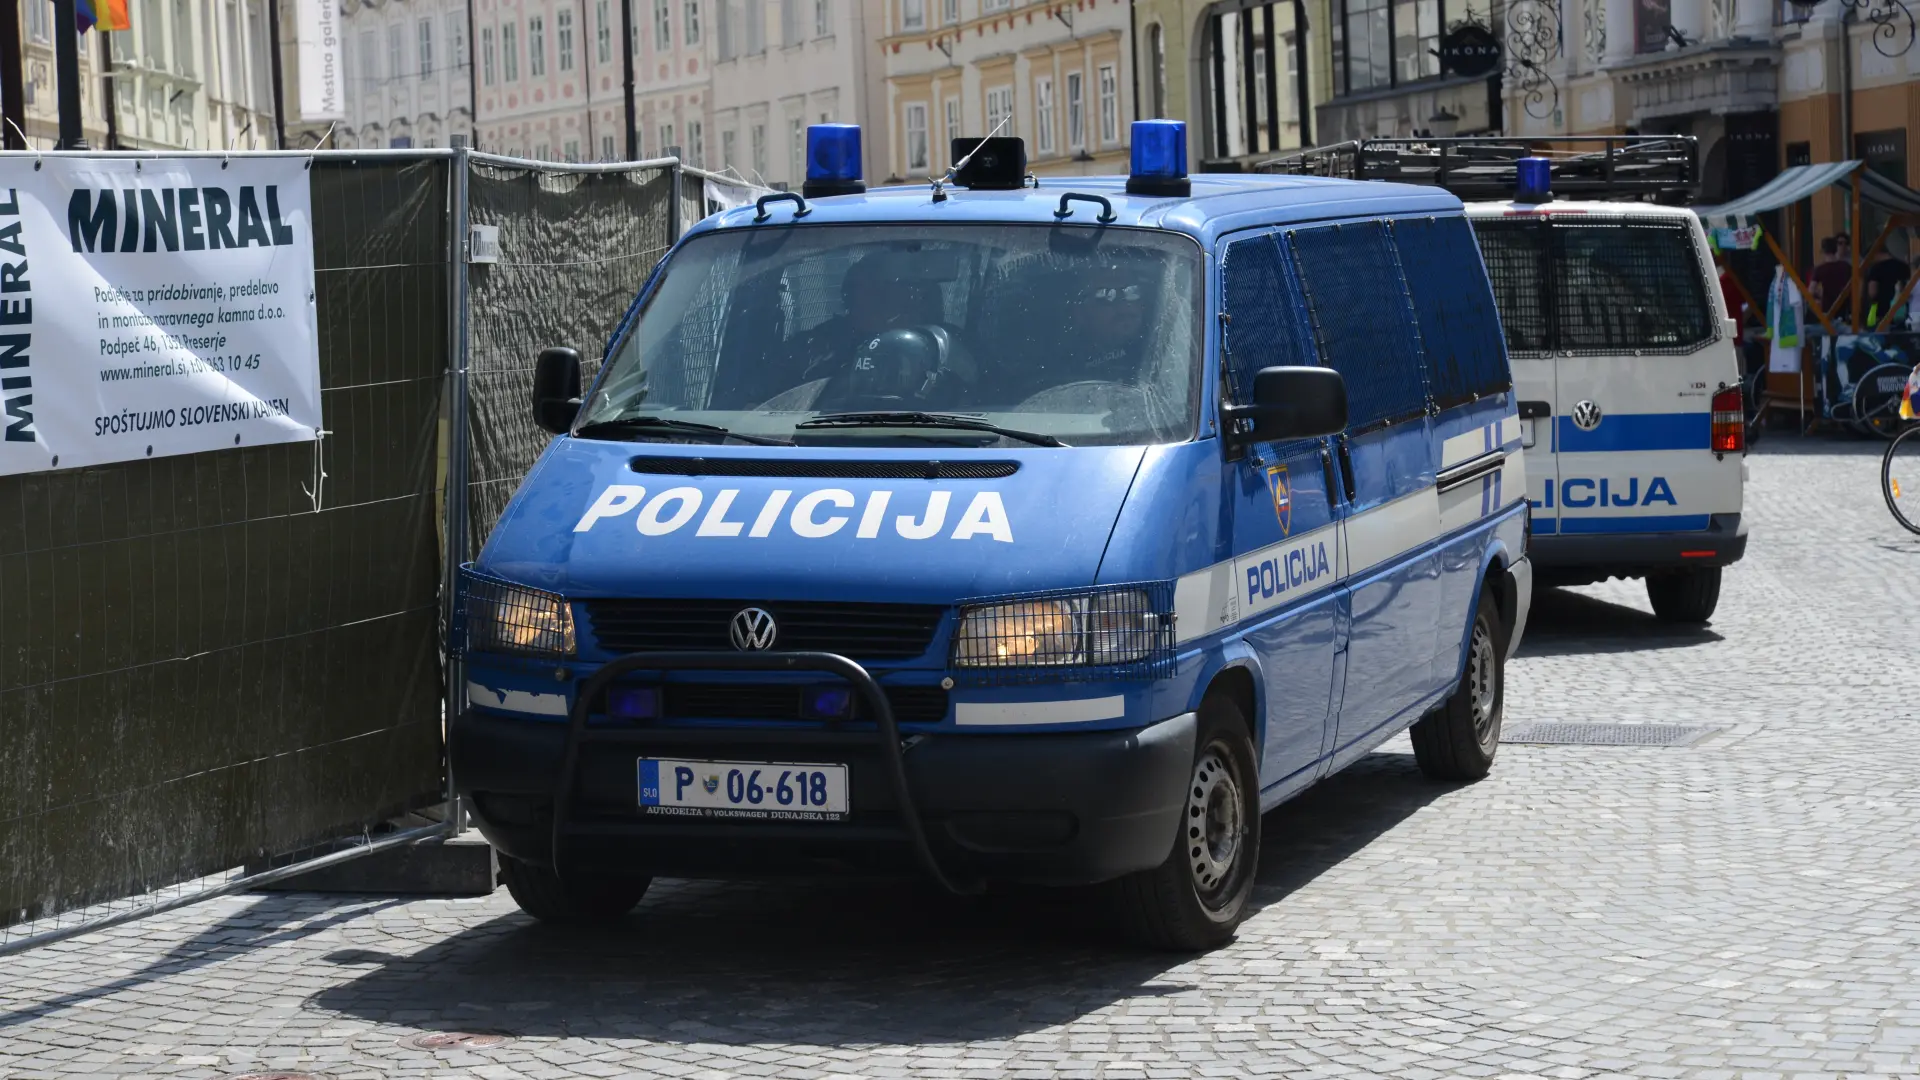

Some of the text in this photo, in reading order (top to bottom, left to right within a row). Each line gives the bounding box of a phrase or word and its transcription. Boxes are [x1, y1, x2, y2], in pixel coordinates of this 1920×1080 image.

[1443, 45, 1500, 57] IKONA
[321, 53, 335, 112] Mestna
[1867, 143, 1896, 154] IKONA
[67, 184, 294, 253] MINERAL
[94, 278, 279, 306] Podjetje za pridobivanje, predelavo
[0, 188, 36, 443] MINERAL
[98, 312, 109, 329] in
[153, 312, 214, 329] naravnega
[217, 306, 255, 323] kamna
[258, 303, 285, 320] d.o.o.
[100, 336, 141, 359] Podpeč
[143, 335, 161, 355] 46,
[182, 331, 227, 352] Preserje
[868, 338, 881, 350] 6
[100, 358, 190, 382] www.mineral.si,
[229, 354, 242, 371] 10
[244, 353, 261, 369] 45
[95, 397, 290, 436] SPOŠTUJMO SLOVENSKI KAMEN
[572, 484, 1015, 544] POLICIJA
[1246, 541, 1330, 605] POLICIJA
[643, 787, 657, 798] SLO
[674, 766, 828, 806] P 06-618
[647, 805, 841, 821] AUTODELTA VOLKSWAGEN DUNAJSKA 122
